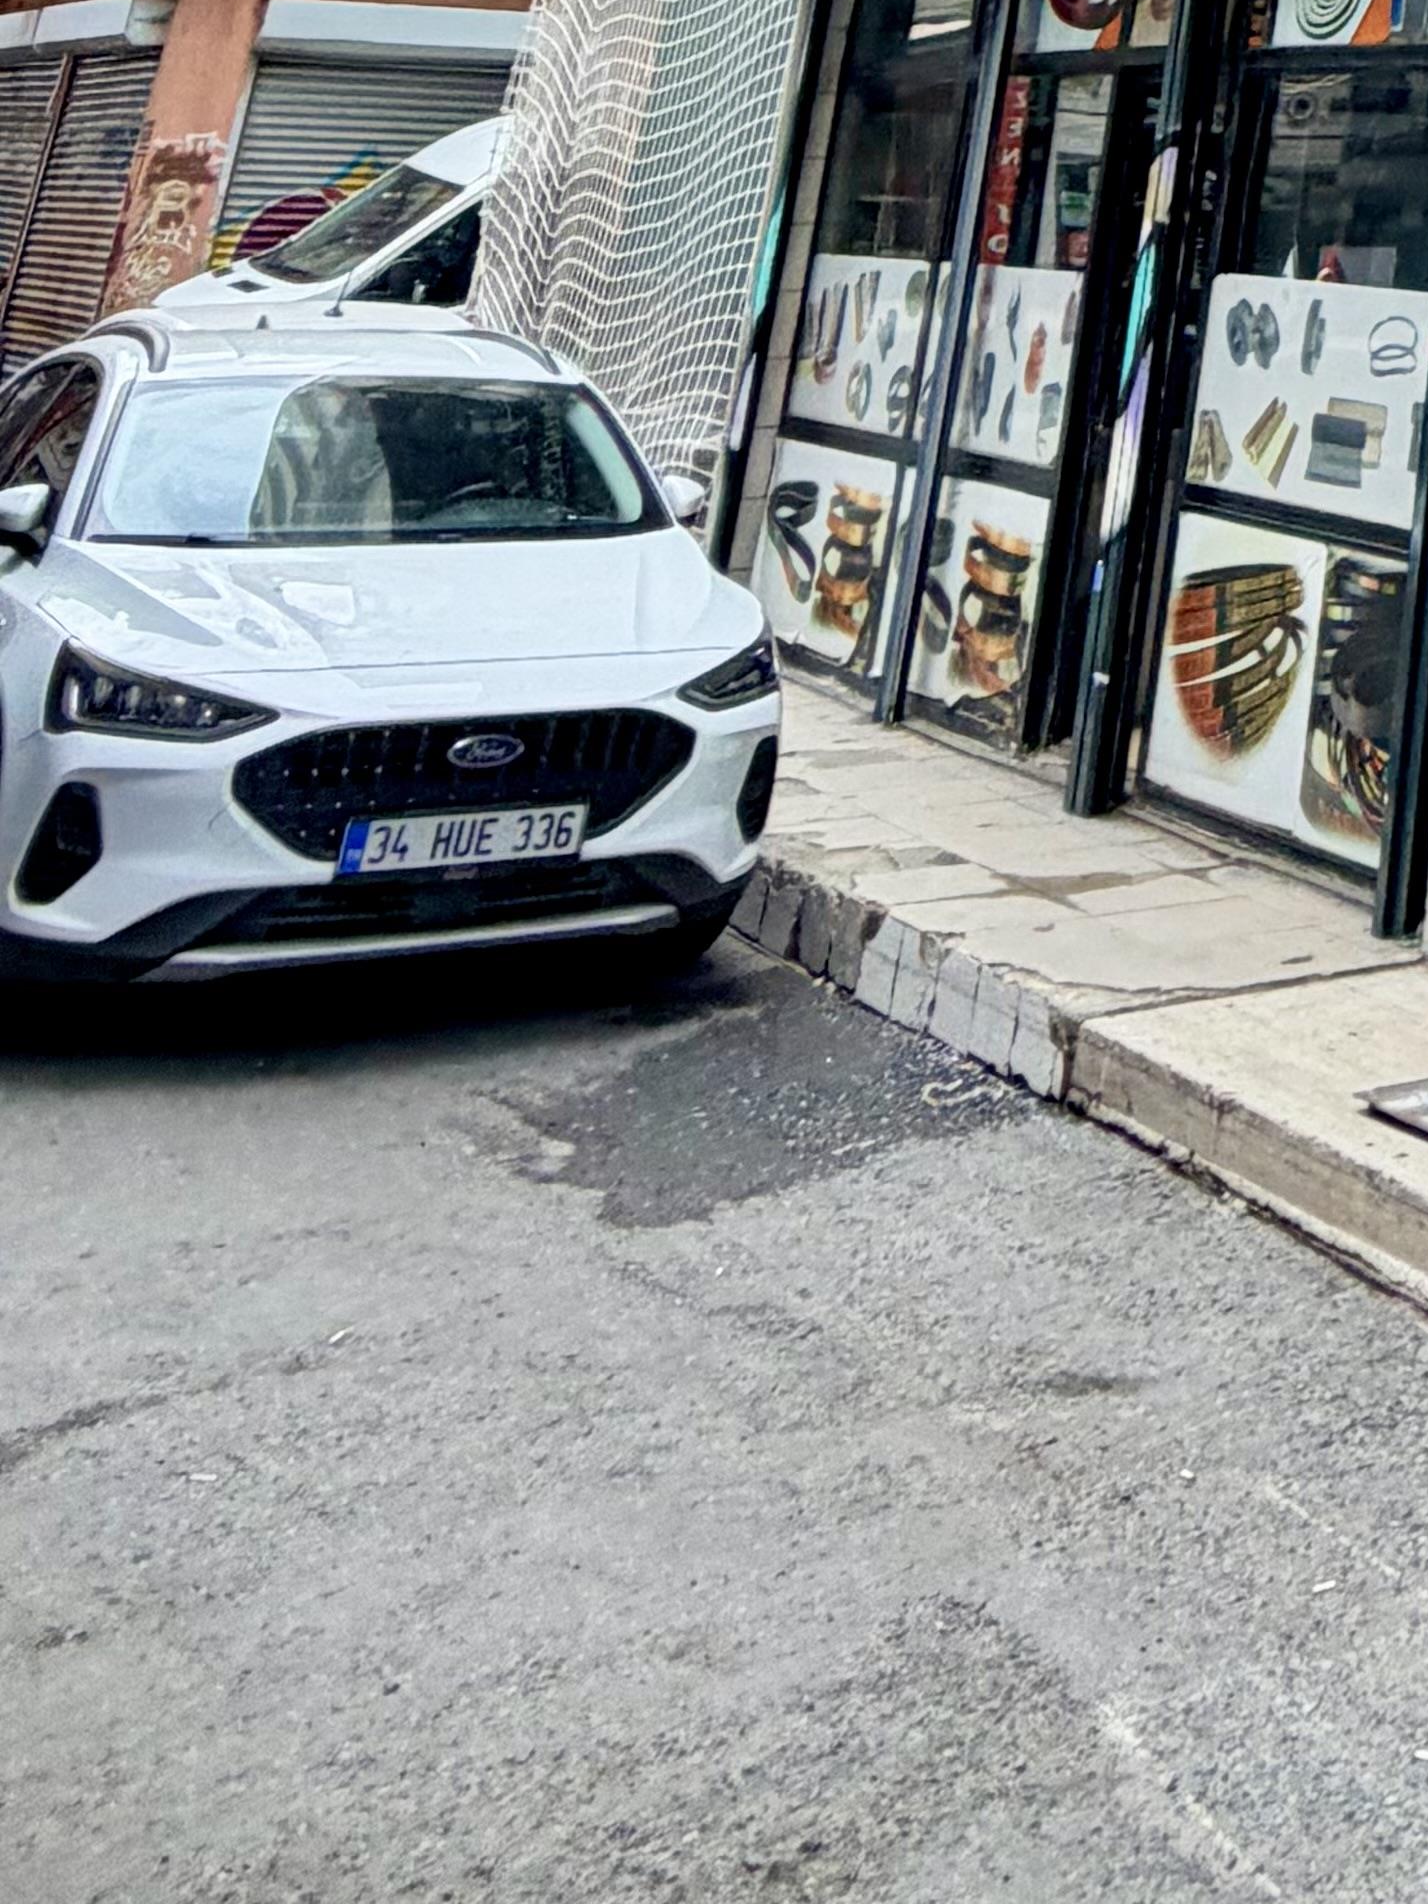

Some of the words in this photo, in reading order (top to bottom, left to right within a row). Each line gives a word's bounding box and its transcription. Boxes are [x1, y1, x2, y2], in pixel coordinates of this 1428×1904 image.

[367, 825, 409, 864] 34
[430, 817, 499, 860] HUE
[512, 811, 576, 852] 336
